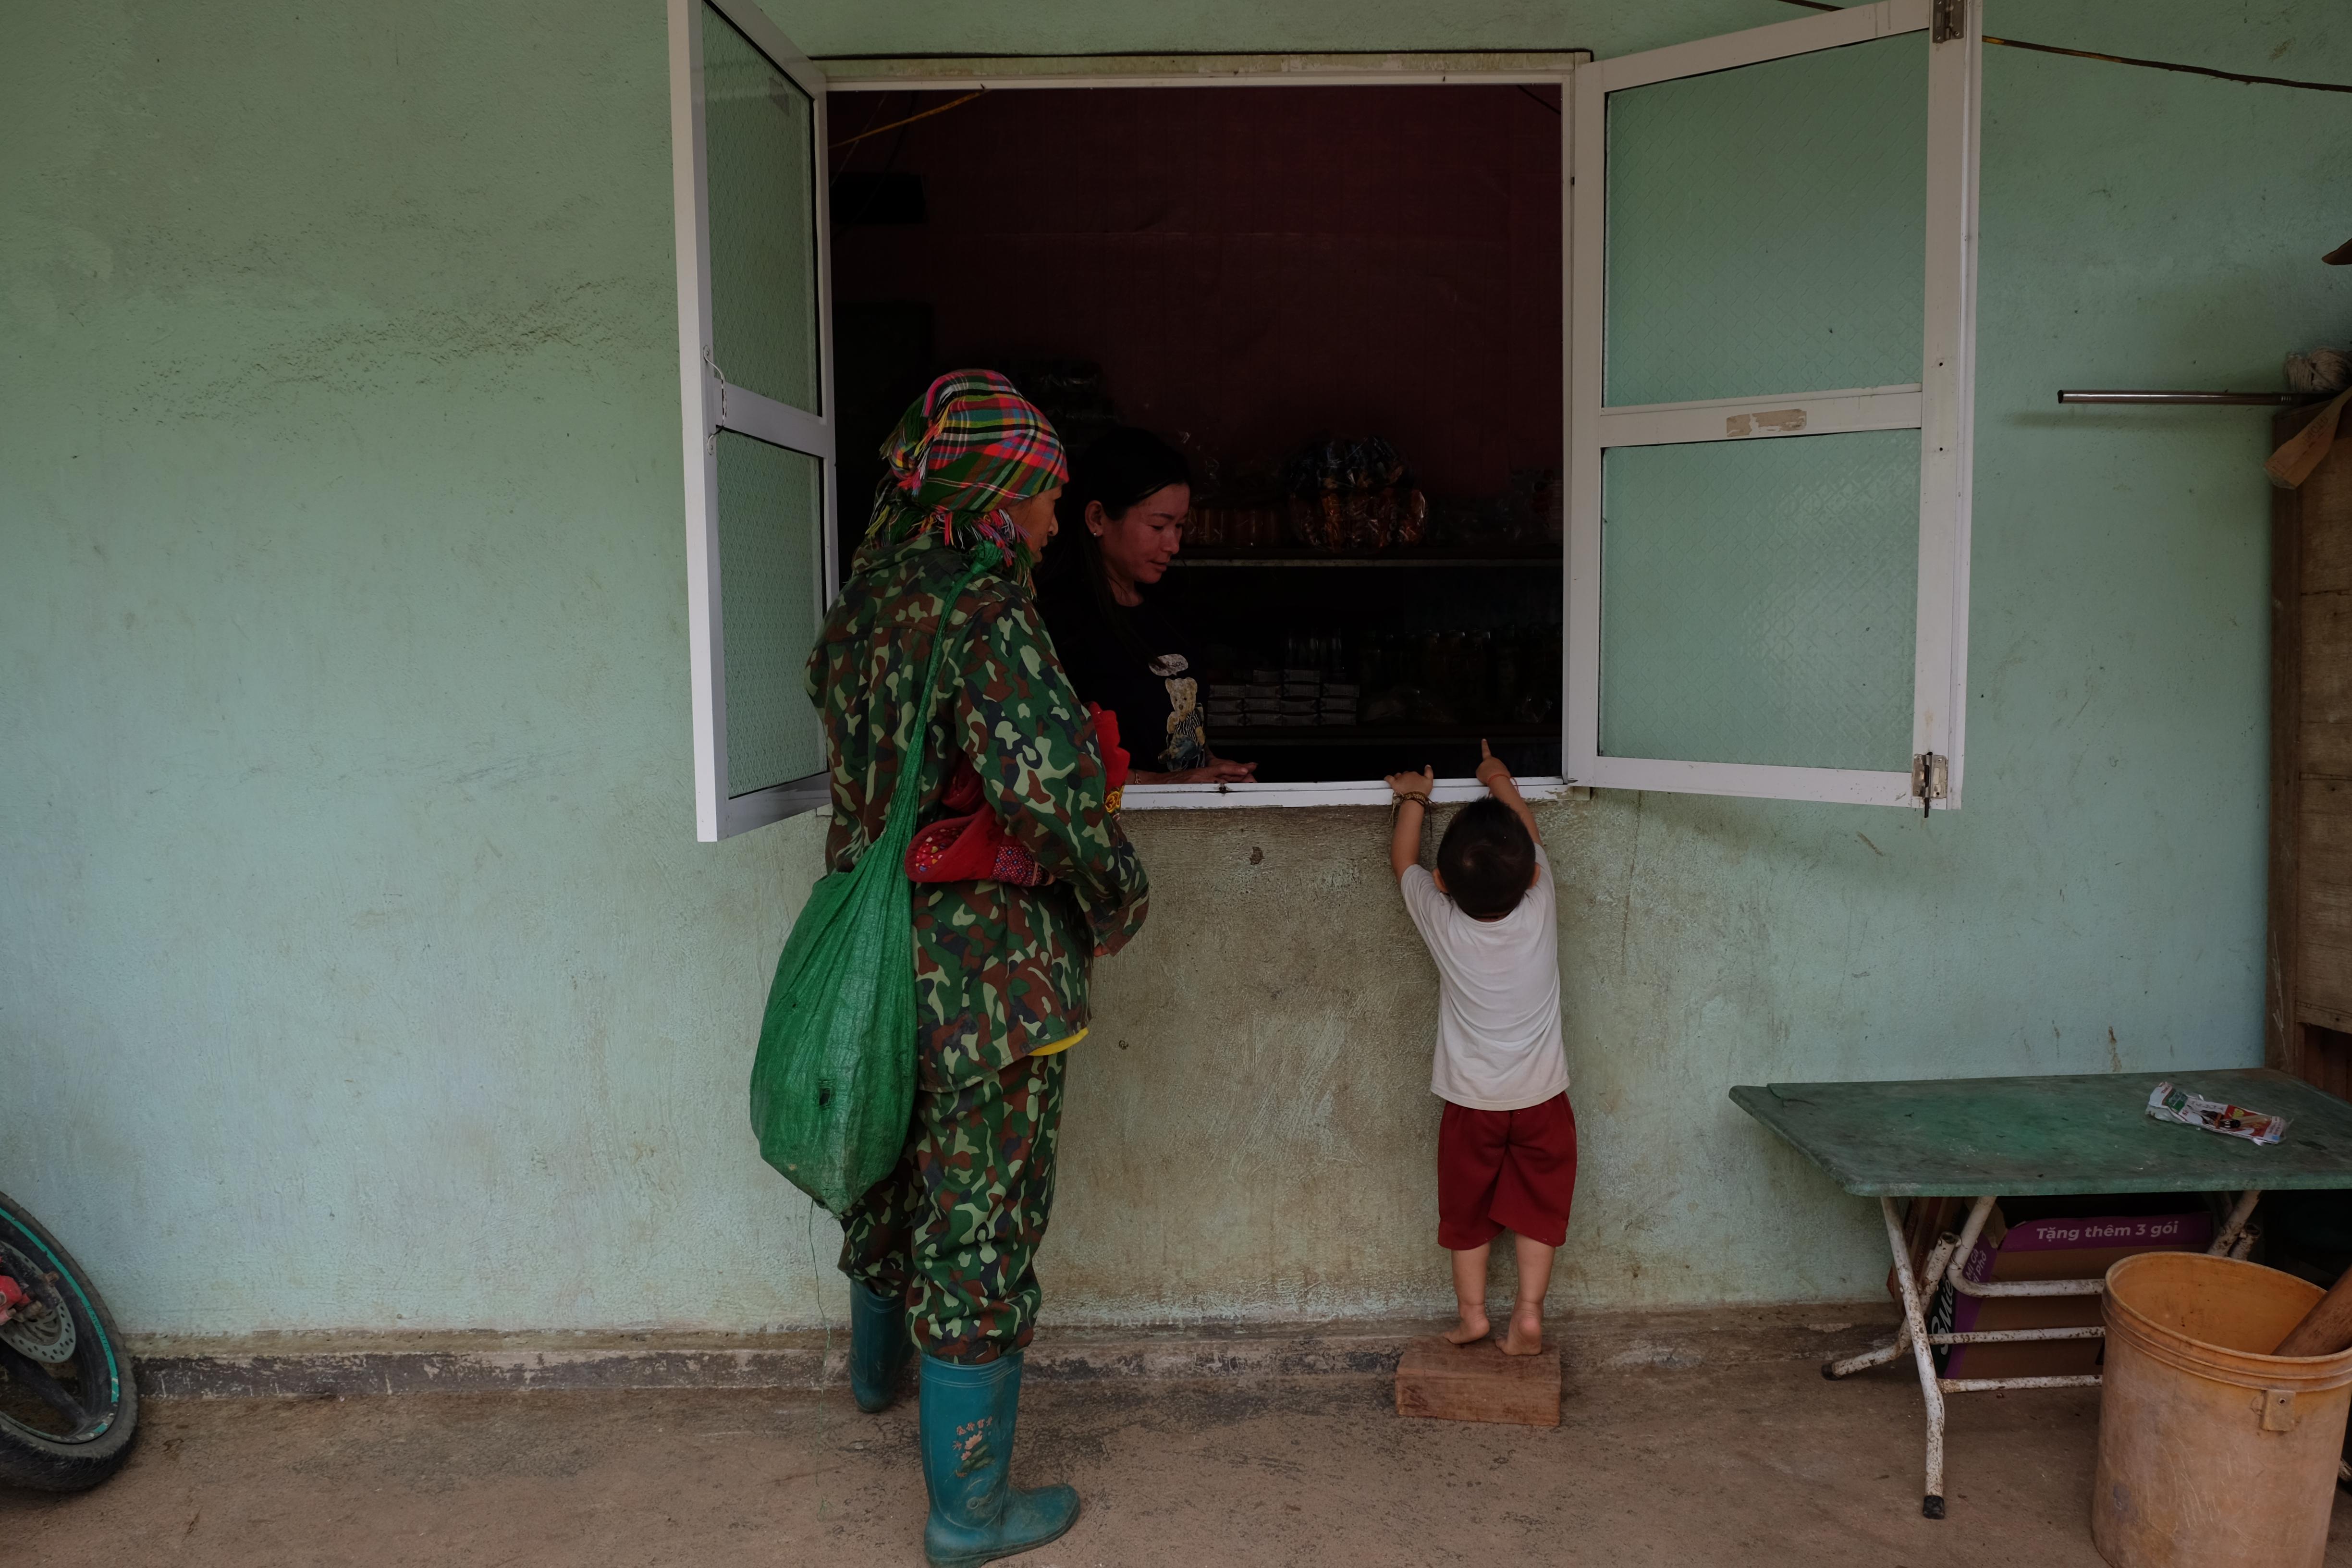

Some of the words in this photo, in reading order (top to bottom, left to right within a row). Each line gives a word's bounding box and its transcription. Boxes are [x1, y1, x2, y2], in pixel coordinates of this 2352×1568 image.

[2036, 1226, 2080, 1242] Tặng
[2085, 1225, 2131, 1238] thêm
[2135, 1224, 2146, 1236] 3
[2150, 1220, 2179, 1238] gói
[1976, 1250, 1986, 1276] Phở
